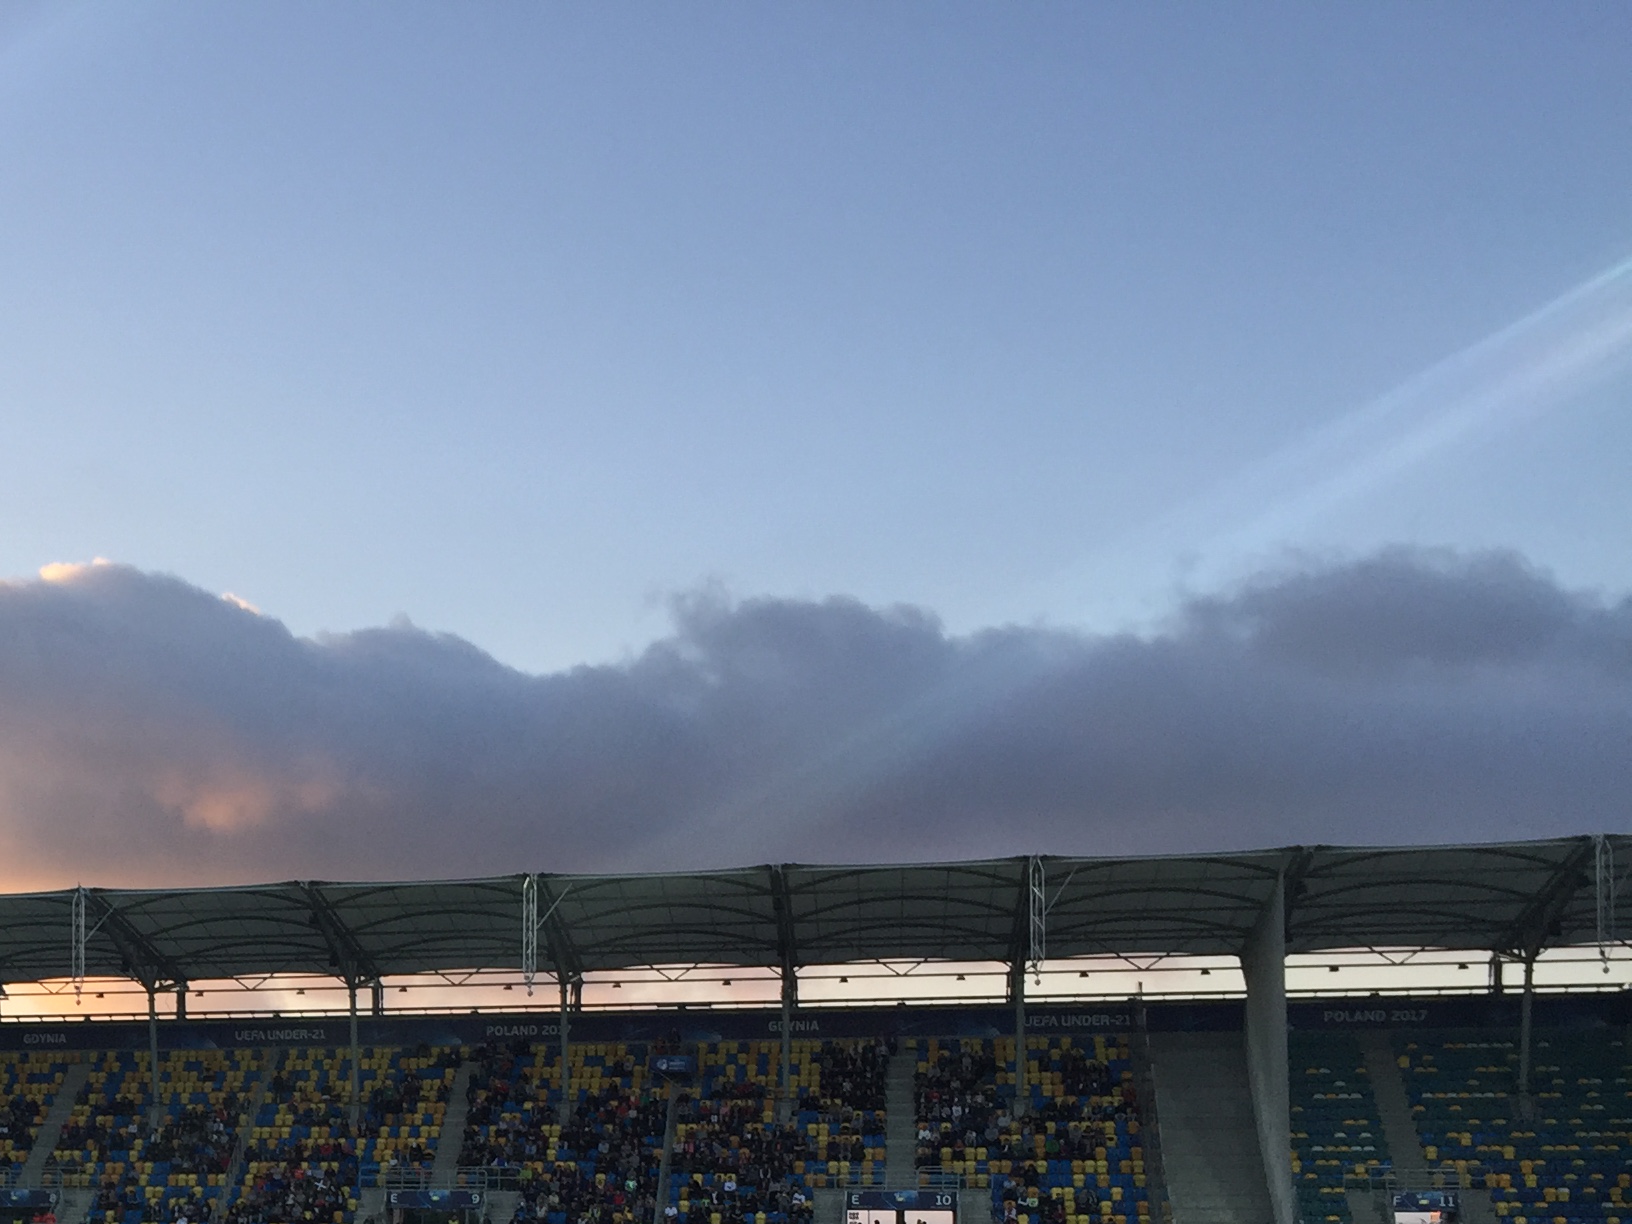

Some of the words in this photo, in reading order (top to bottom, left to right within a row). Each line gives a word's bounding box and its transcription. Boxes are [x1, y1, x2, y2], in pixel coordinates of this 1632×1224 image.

[1023, 1015, 1058, 1027] UEFA
[1061, 1014, 1131, 1027] UNDER-21
[1324, 1010, 1387, 1022] POLAND
[1391, 1010, 1428, 1021] 2017
[235, 1029, 266, 1041] UEFA
[268, 1028, 326, 1040] UNDER-21
[486, 1025, 538, 1037] POLAND
[23, 1033, 67, 1045] GDYNIA
[390, 1193, 398, 1203] E
[472, 1193, 480, 1204] 9
[851, 1194, 860, 1205] E
[935, 1194, 952, 1206] 10
[1393, 1196, 1401, 1206] F
[1439, 1196, 1455, 1207] 11
